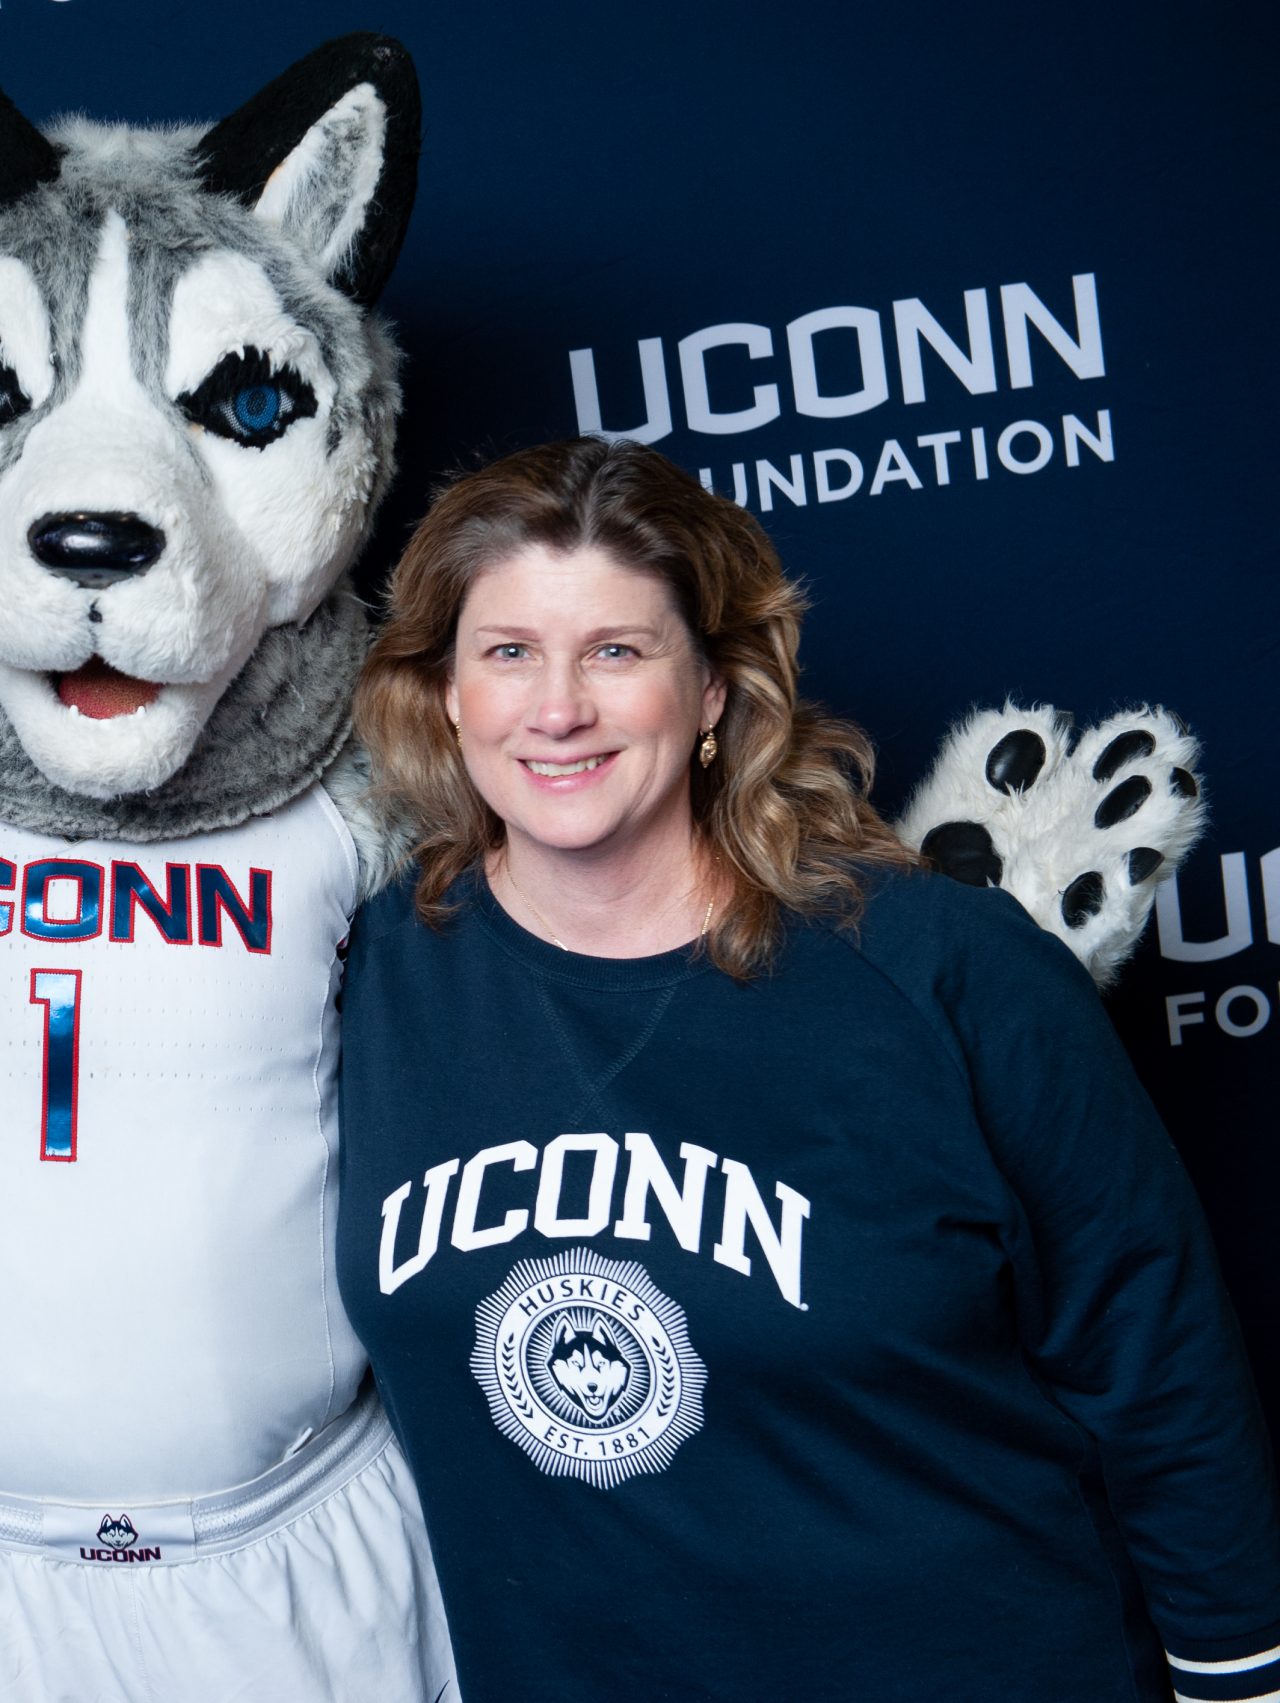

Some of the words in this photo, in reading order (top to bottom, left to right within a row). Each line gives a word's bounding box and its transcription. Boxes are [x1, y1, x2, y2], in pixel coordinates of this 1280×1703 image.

[569, 272, 1106, 446] UCONN
[698, 409, 1115, 513] UNDATION
[29, 967, 83, 1162] 1
[379, 1132, 811, 1308] UCONN
[518, 1278, 646, 1321] HUSKIES
[543, 1425, 589, 1455] EST.
[599, 1426, 651, 1456] 1881
[79, 1546, 162, 1563] UCONN
